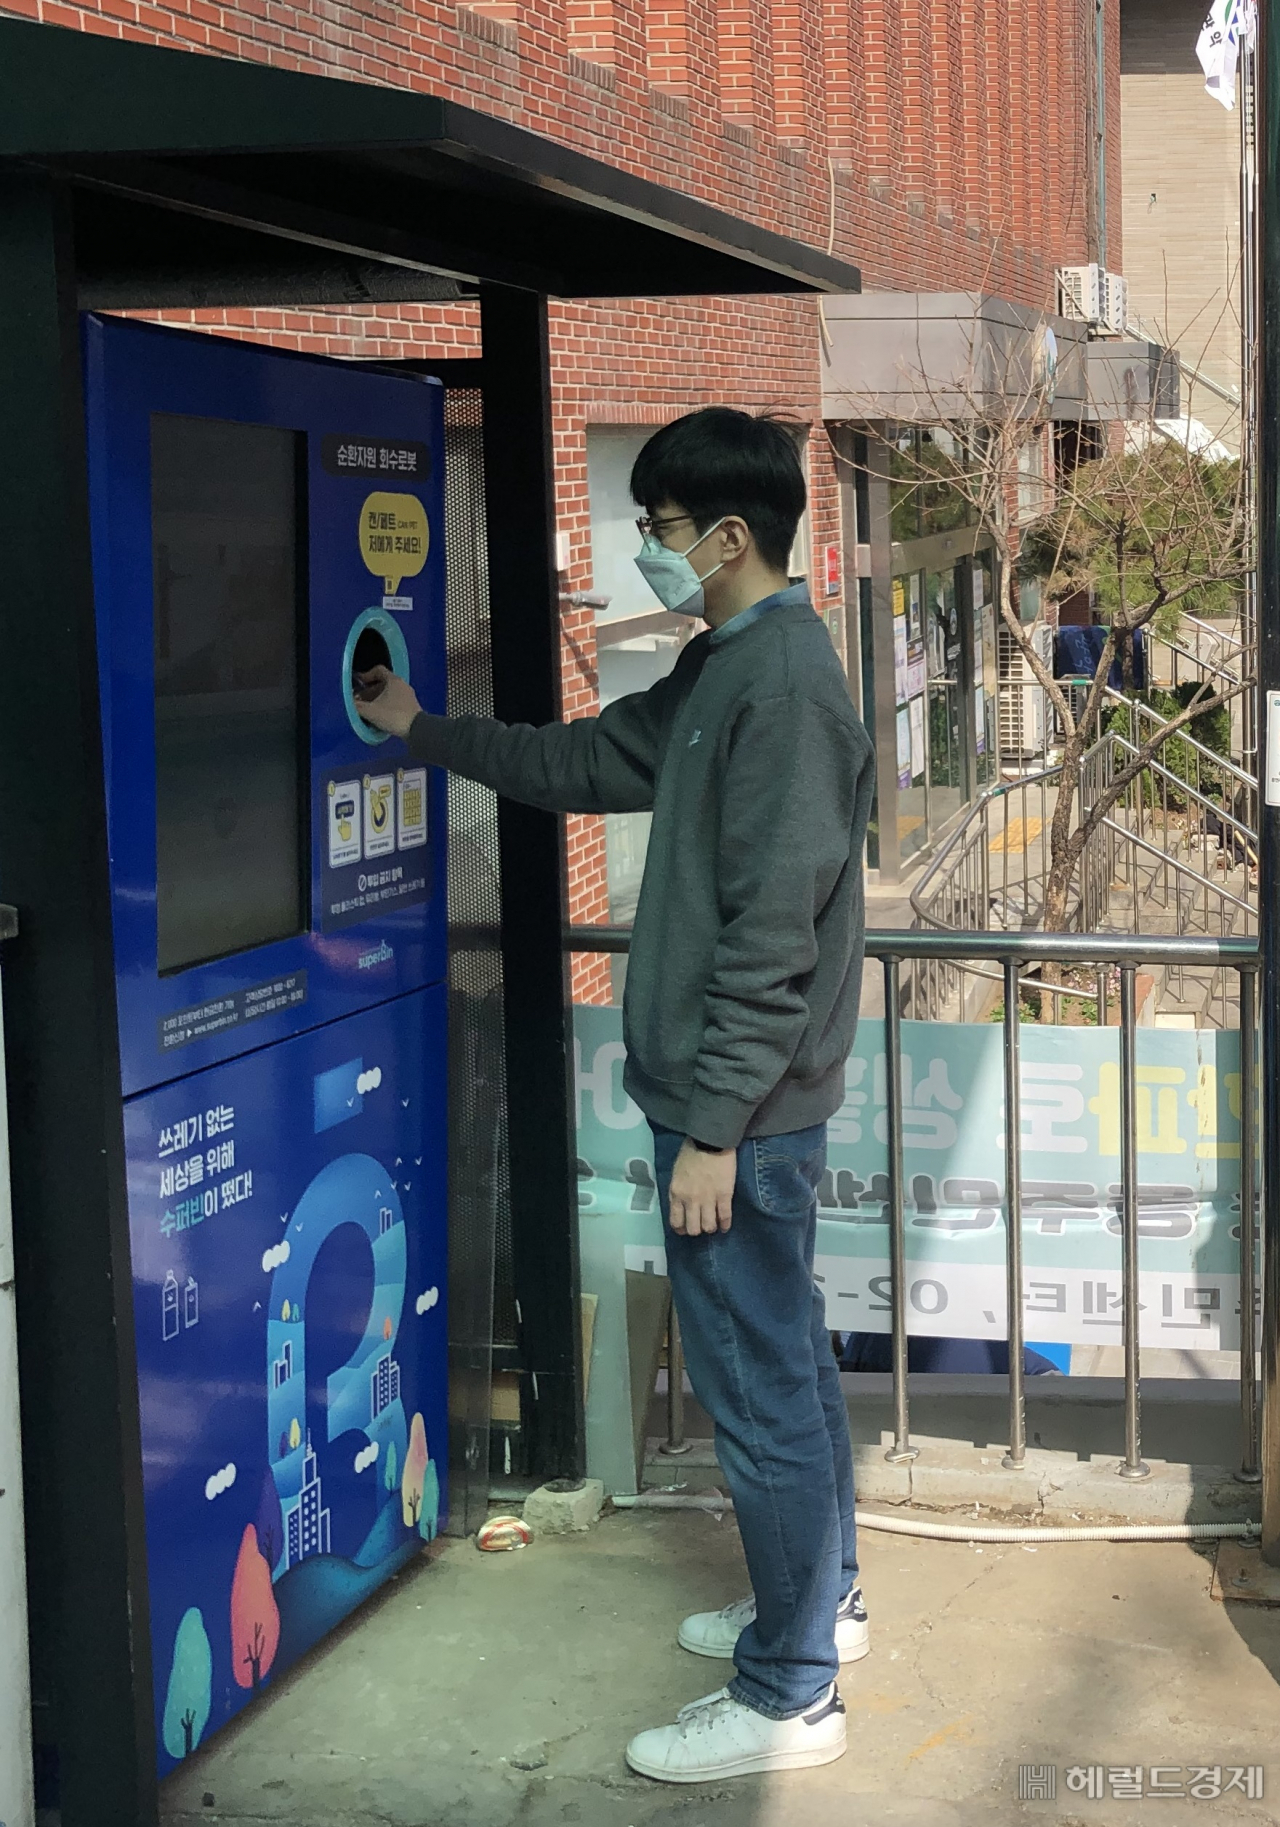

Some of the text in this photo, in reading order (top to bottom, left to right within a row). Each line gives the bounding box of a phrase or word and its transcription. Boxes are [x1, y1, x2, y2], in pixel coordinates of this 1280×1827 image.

[337, 444, 418, 472] 순환자원 회수로봇
[368, 511, 397, 530] 캔/페트
[368, 535, 421, 555] 저에게 주세요!
[158, 1104, 235, 1159] 쓰레기 없는
[159, 1140, 236, 1200] 세상을 위해
[159, 1169, 253, 1239] 수퍼빈이 떴다!
